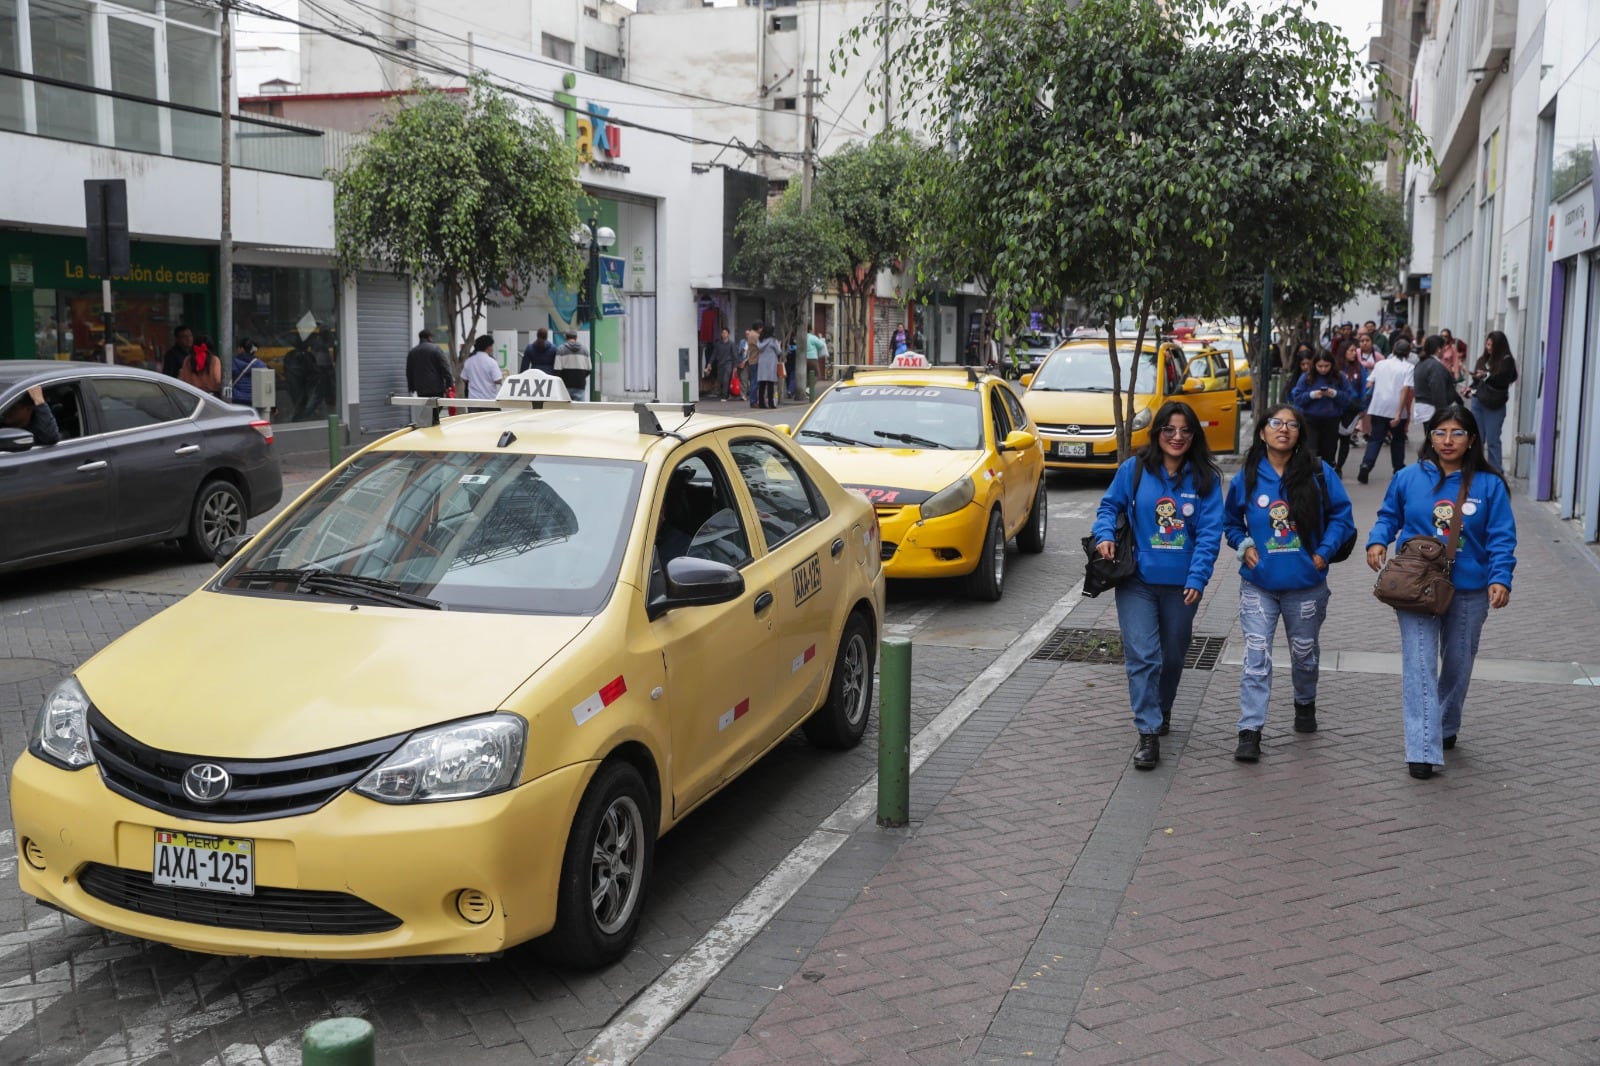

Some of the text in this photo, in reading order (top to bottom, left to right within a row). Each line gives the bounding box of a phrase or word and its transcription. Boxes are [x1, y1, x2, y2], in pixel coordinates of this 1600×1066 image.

[65, 260, 84, 278] La
[155, 265, 173, 283] de
[176, 271, 210, 285] crear
[897, 357, 922, 367] TAXI
[508, 379, 553, 397] TAXI
[794, 558, 820, 601] AXA-125
[158, 845, 248, 885] AXA-125
